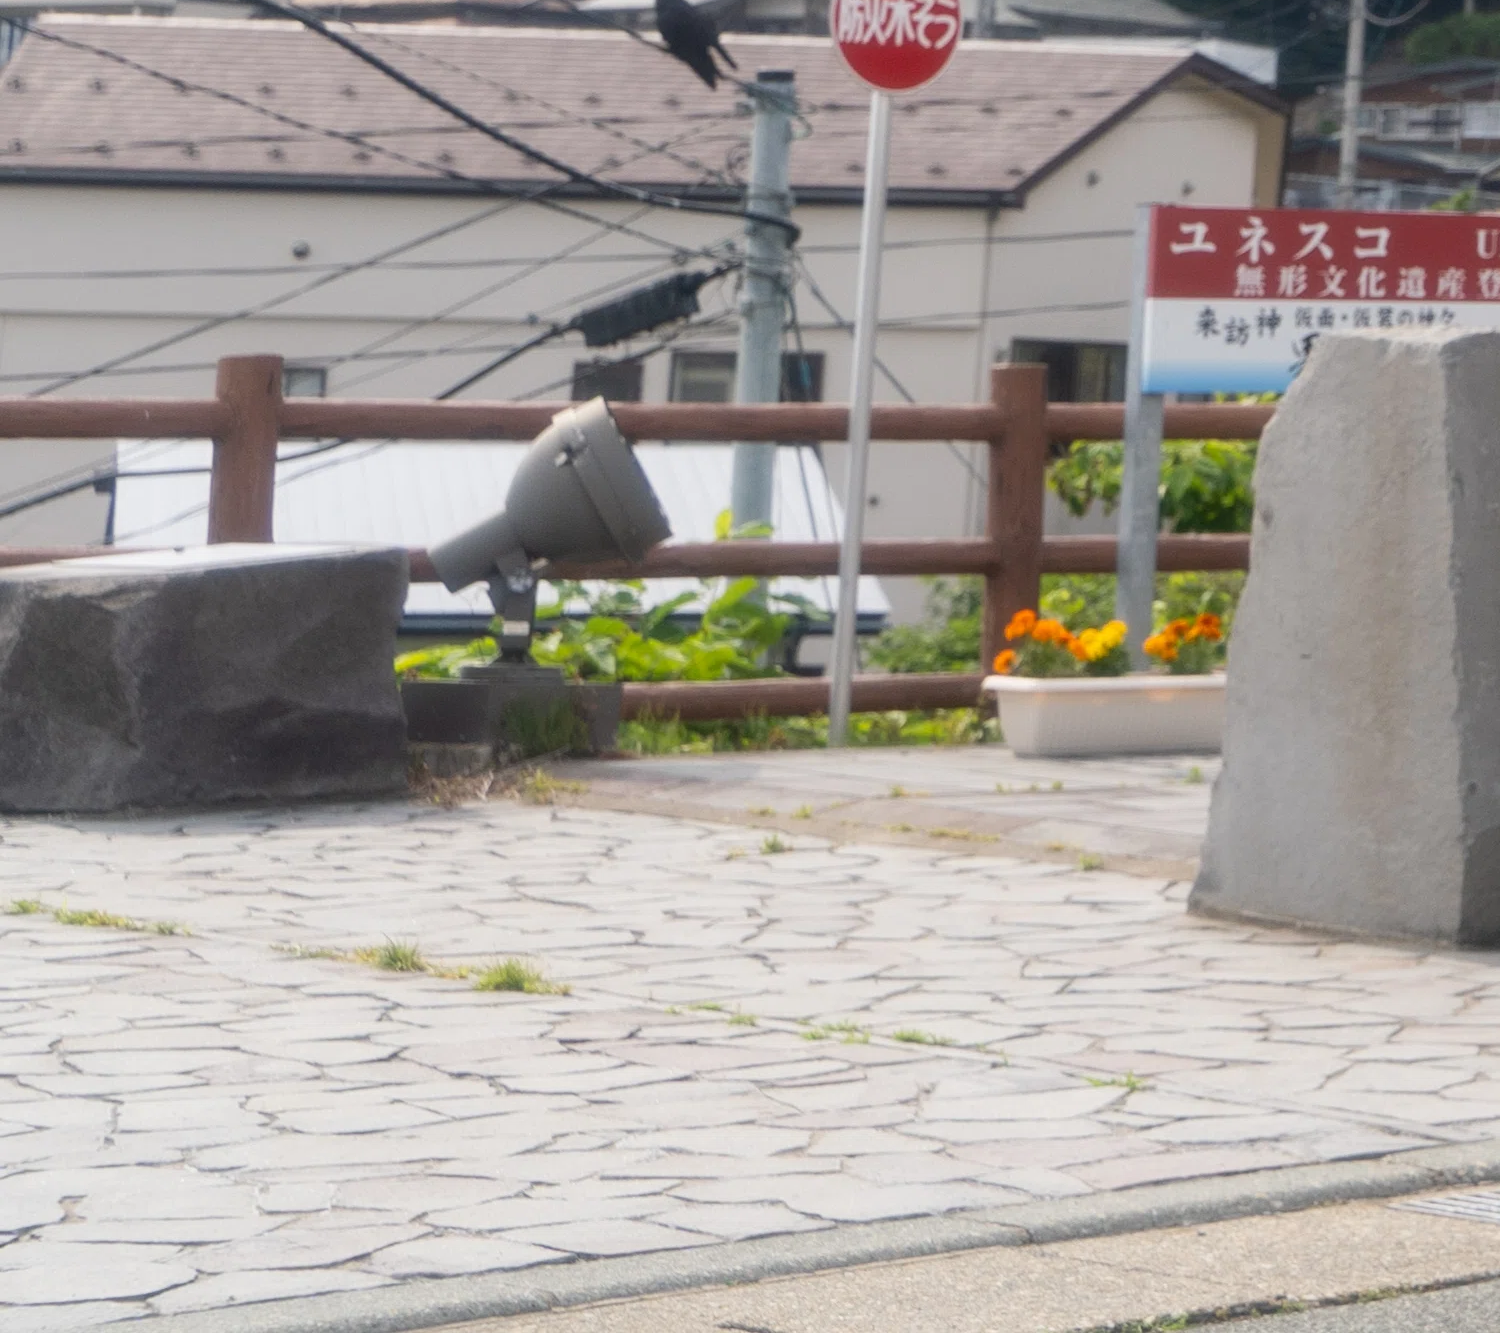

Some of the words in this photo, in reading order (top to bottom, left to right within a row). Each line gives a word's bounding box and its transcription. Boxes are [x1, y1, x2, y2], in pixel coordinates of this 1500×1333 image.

[1170, 217, 1391, 261] ユネスコ
[1197, 305, 1282, 346] 来訪神
